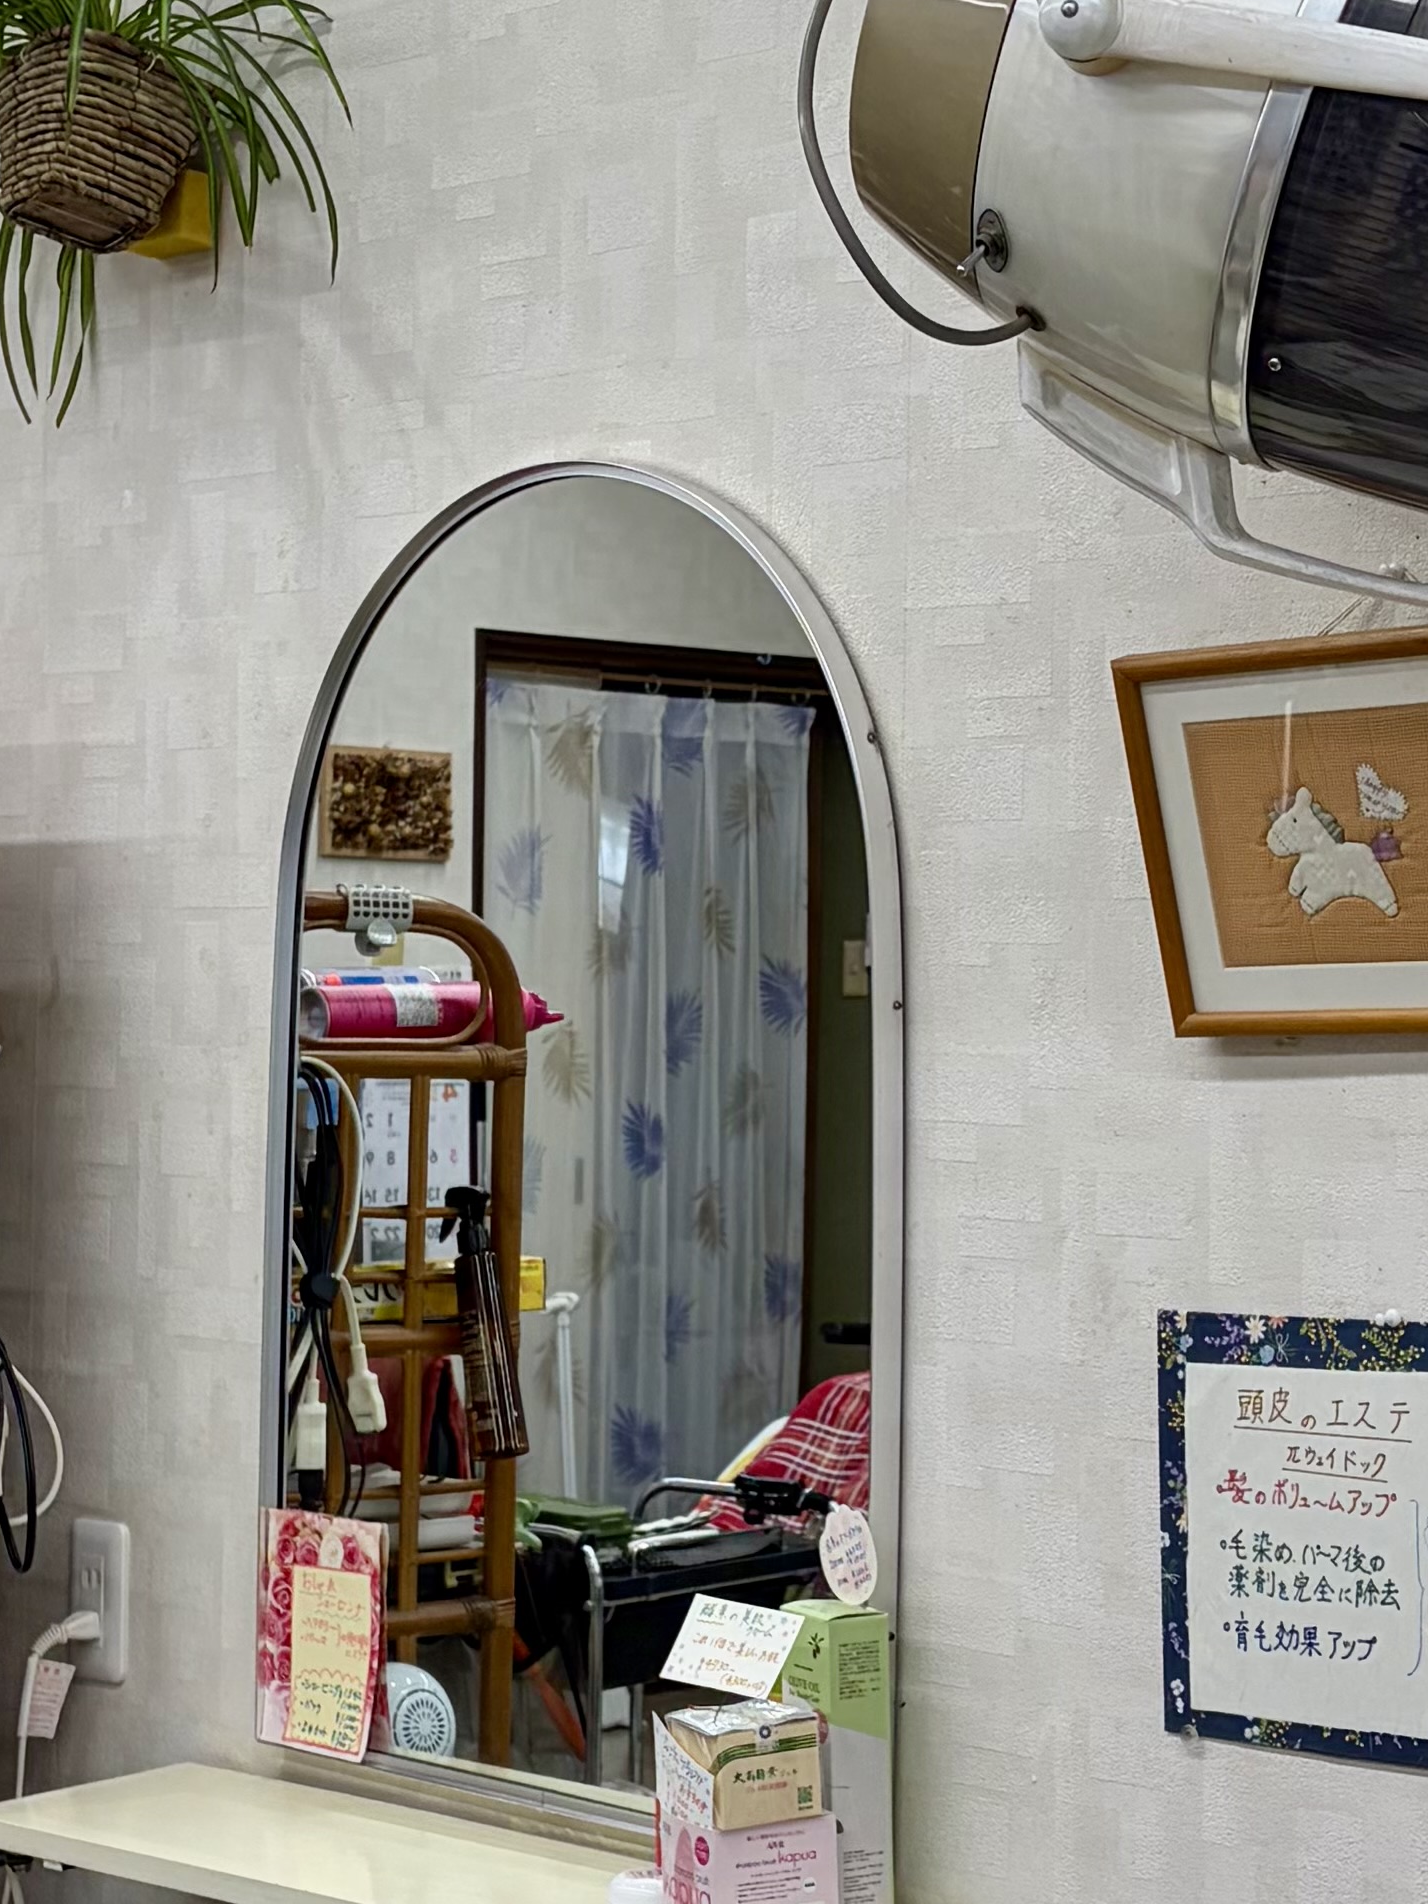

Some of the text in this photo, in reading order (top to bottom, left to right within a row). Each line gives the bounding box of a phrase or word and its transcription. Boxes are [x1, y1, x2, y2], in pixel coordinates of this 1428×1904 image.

[1236, 1387, 1412, 1435] 頭皮のエステ
[1228, 1567, 1402, 1611] 薬剤を完全に除去
[1234, 1611, 1378, 1662] 育毛効果アップ
[778, 1849, 817, 1868] kapua
